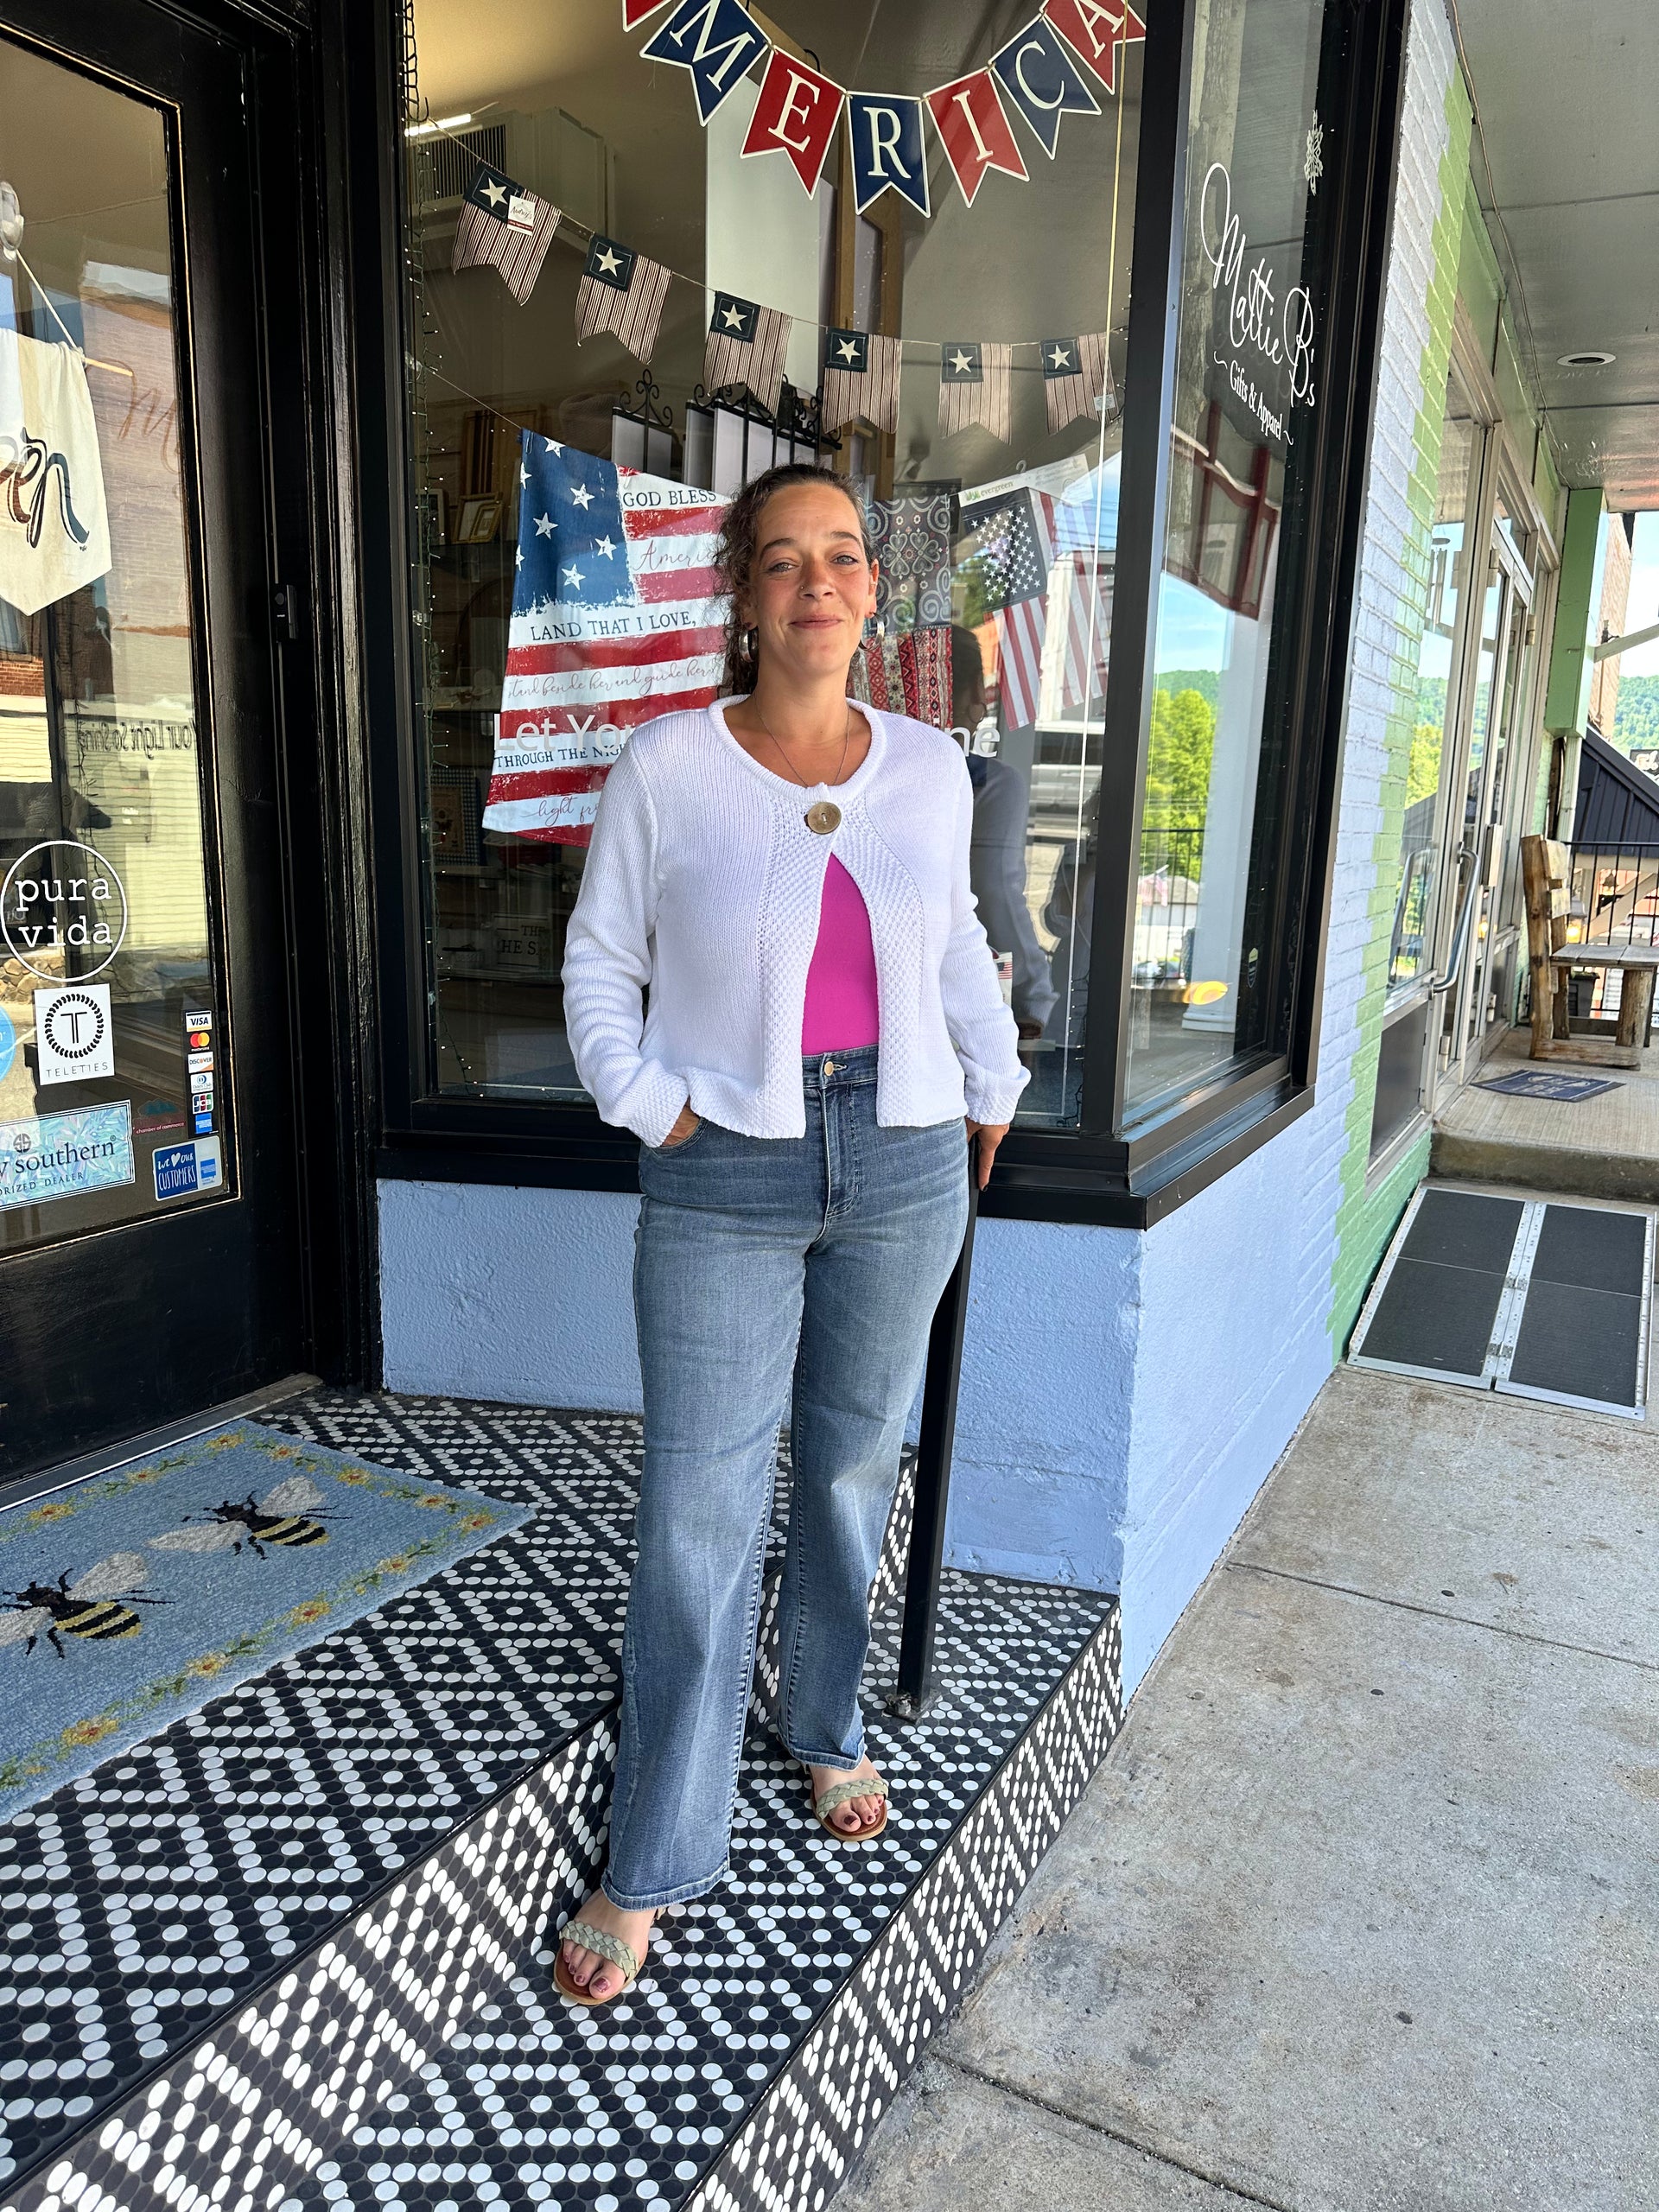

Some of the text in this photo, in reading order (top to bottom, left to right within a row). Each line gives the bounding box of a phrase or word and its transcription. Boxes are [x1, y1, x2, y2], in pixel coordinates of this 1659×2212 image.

[669, 0, 1125, 179] MERICA
[1200, 162, 1315, 408] Mattie B's
[1230, 359, 1283, 441] Gifts & Apparel
[0, 427, 90, 549] en
[622, 489, 717, 507] GOD BLESS
[980, 480, 1014, 497] evergreen
[633, 539, 714, 571] Americ
[531, 611, 696, 641] LAND THAT I LOVE,
[542, 676, 585, 696] beside
[589, 670, 613, 691] her
[613, 667, 642, 687] and
[639, 663, 683, 696] guide
[493, 714, 635, 753] Let Yo
[494, 750, 554, 768] THROUGH
[558, 746, 588, 760] THE
[519, 797, 600, 827] light fr
[14, 877, 112, 912] pura
[17, 914, 114, 948] vida
[190, 1016, 209, 1027] VISA
[46, 1061, 109, 1078] TELETIES
[189, 1057, 213, 1065] DISCOVER
[136, 1126, 156, 1135] chamber
[162, 1122, 185, 1130] commerce
[15, 1140, 116, 1174] southern
[44, 1172, 84, 1187] DEALER
[158, 1164, 197, 1192] CUSTOMERS
